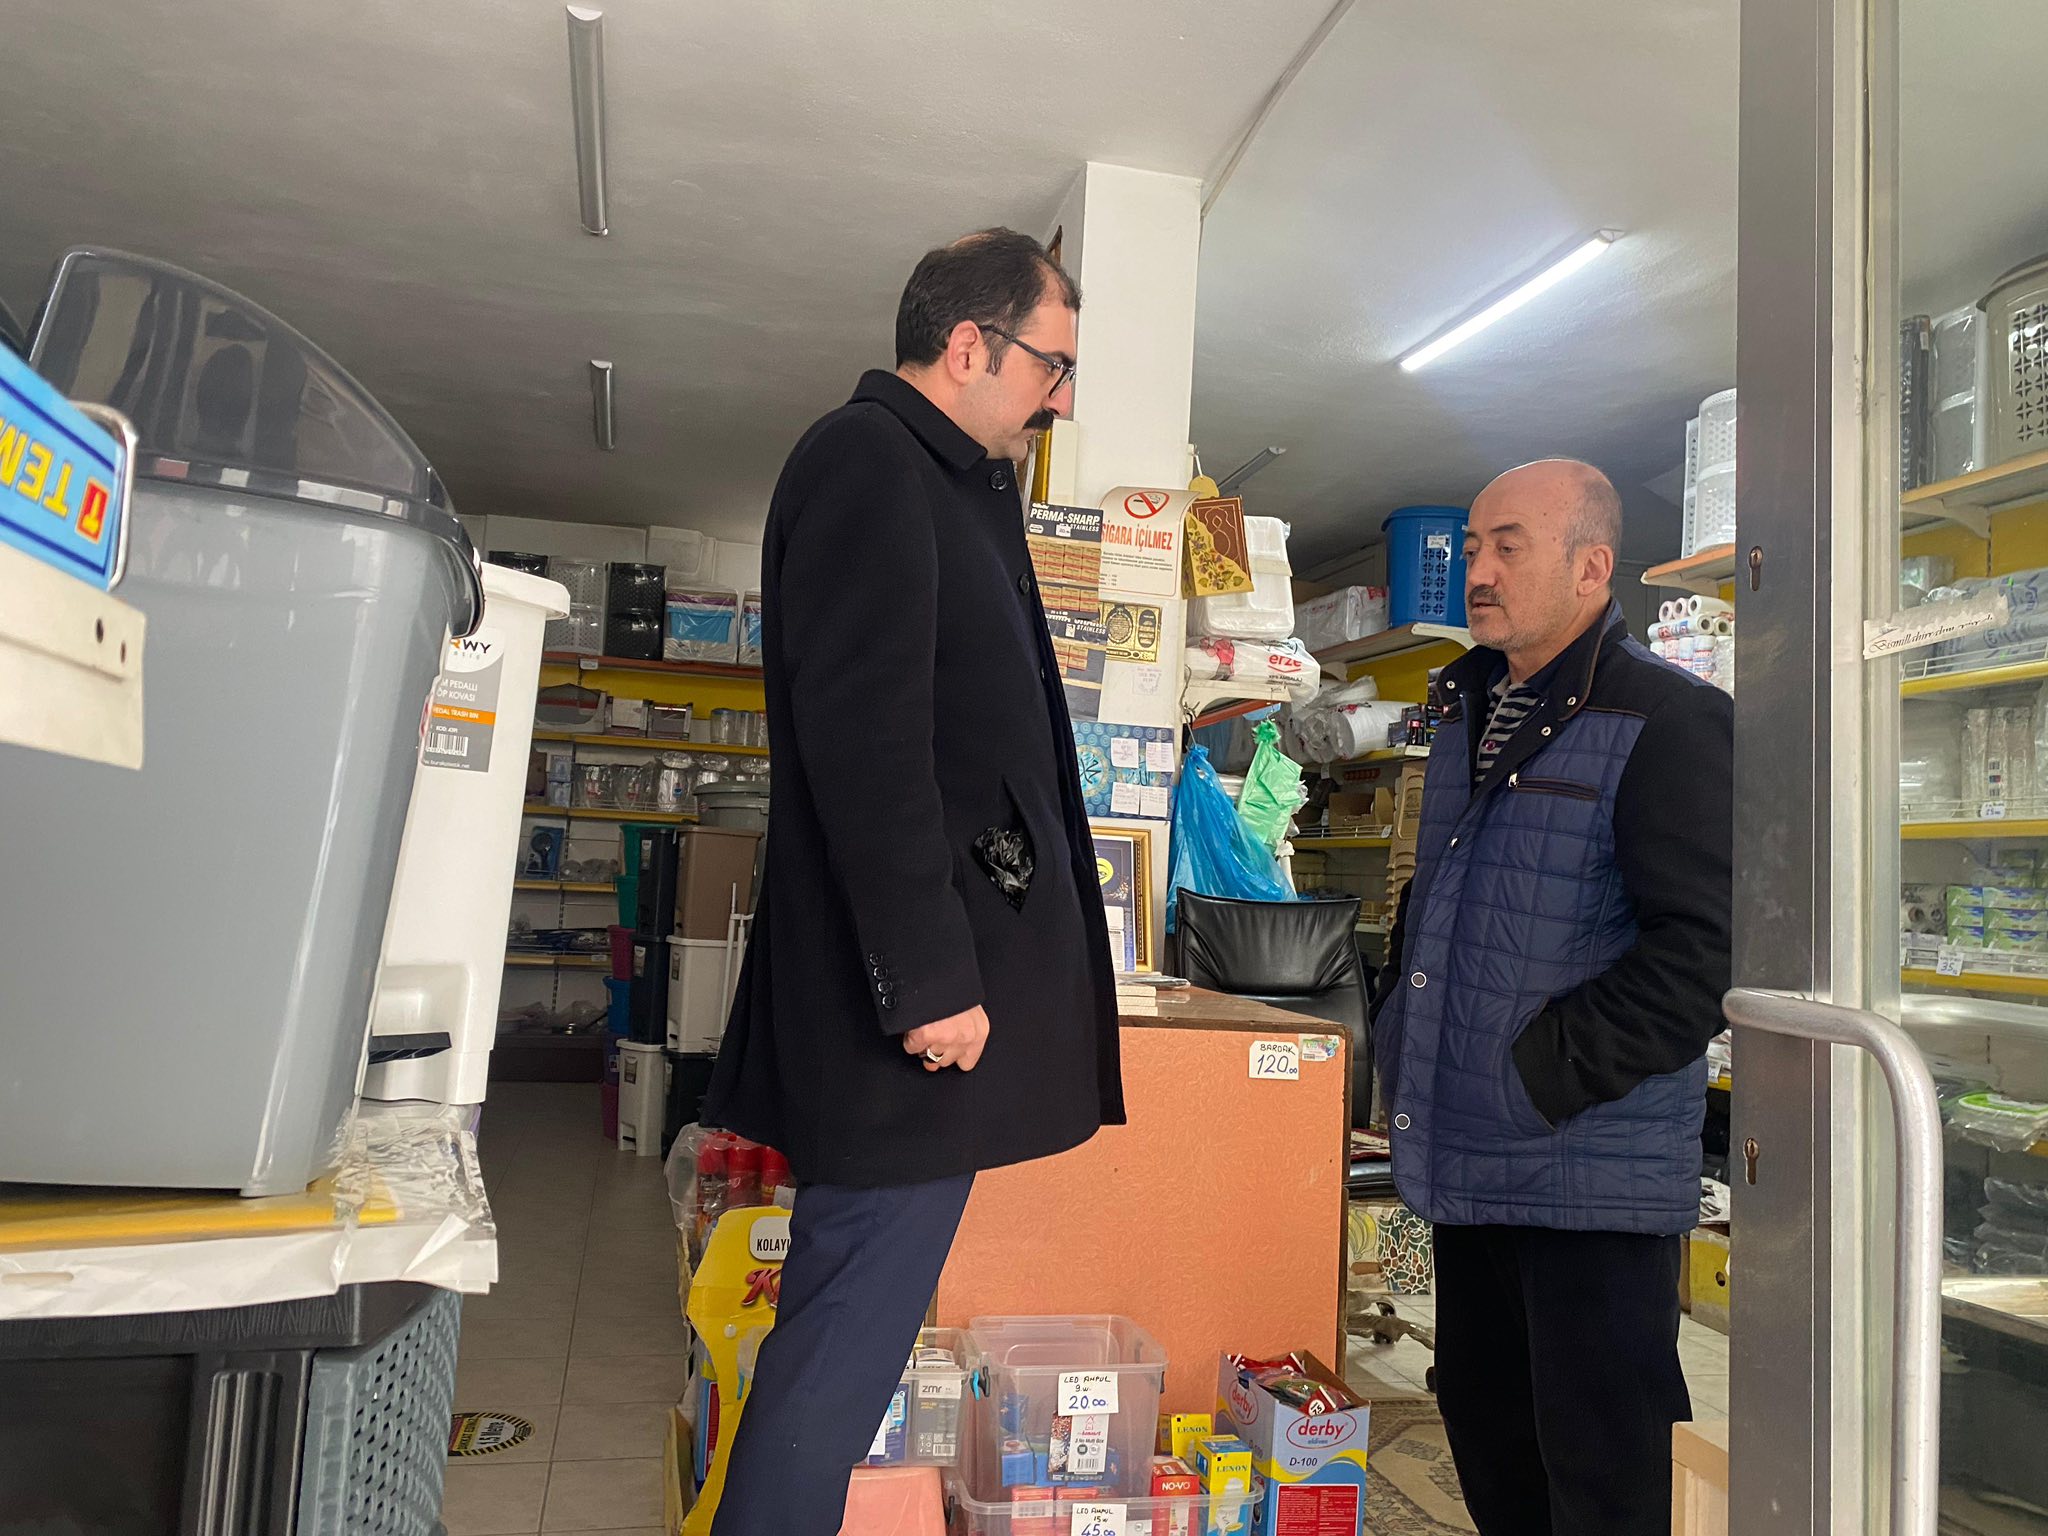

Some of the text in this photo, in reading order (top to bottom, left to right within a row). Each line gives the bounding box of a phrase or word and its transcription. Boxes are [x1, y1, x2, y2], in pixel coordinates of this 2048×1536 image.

[1030, 508, 1100, 525] PERMA-SHARP
[1070, 524, 1099, 532] STAINLESS
[1101, 520, 1132, 546] SİGARA
[1134, 524, 1173, 552] İÇİLMEZ
[1076, 624, 1106, 635] STAINLESS
[1269, 653, 1302, 668] erze
[435, 687, 449, 698] ÖP
[1260, 1043, 1297, 1056] BARDAK
[922, 1385, 943, 1393] zmr
[1297, 1418, 1345, 1441] derby
[1289, 1457, 1318, 1467] D-100
[1215, 1464, 1248, 1473] LENON
